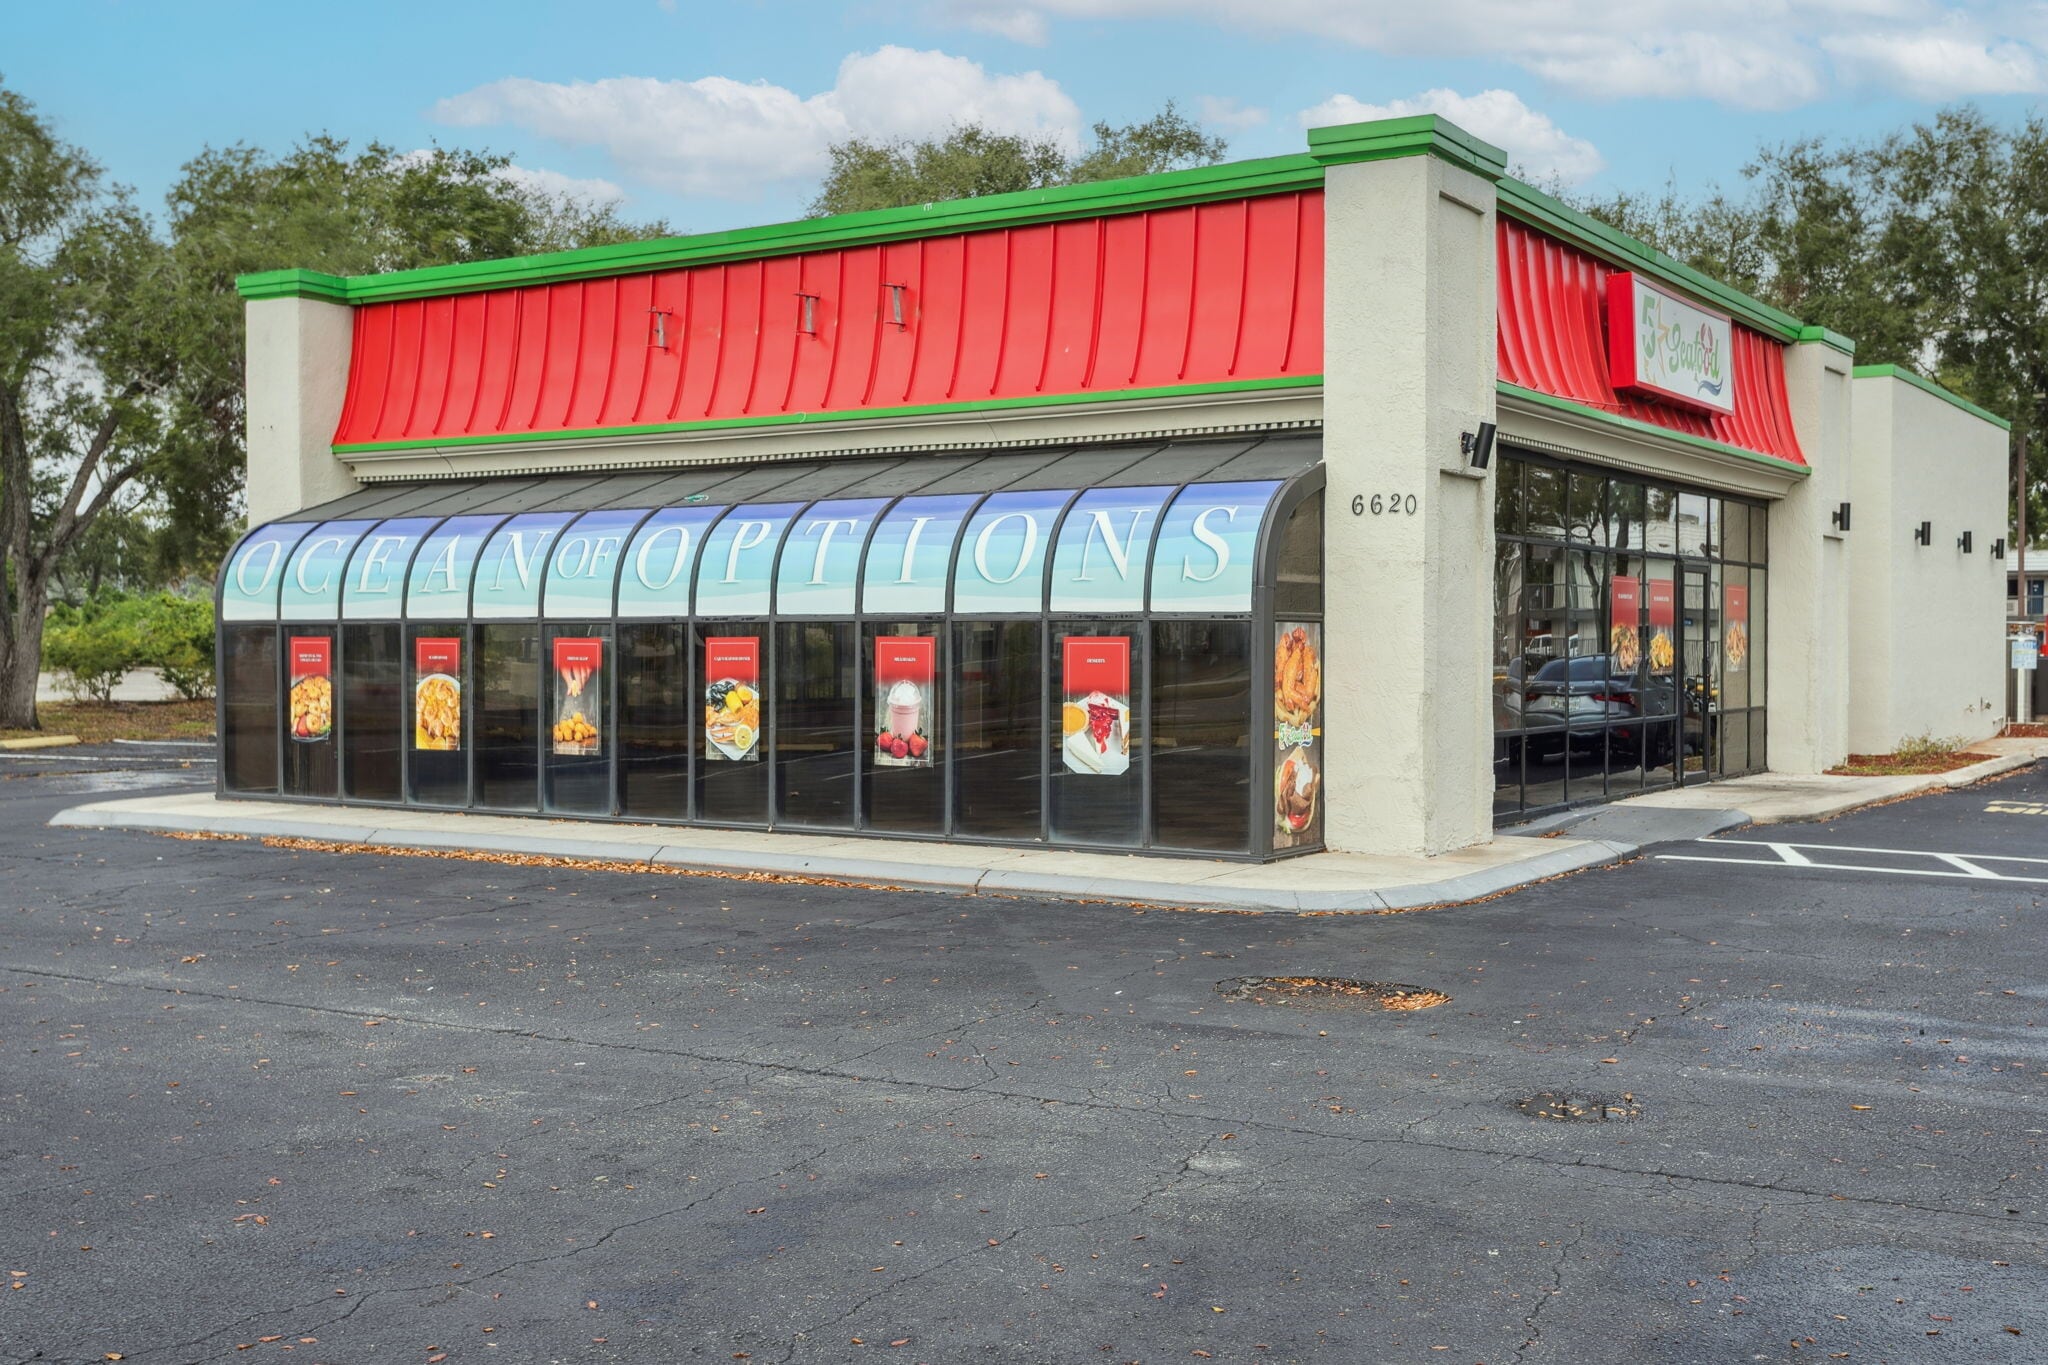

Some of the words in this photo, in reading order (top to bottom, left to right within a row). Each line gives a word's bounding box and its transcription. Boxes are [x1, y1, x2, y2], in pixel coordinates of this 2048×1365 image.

[1642, 294, 1656, 359] 5
[1666, 322, 1720, 381] Seafood
[1351, 493, 1417, 516] 6620
[236, 530, 554, 596] OCEAN
[556, 537, 620, 579] OF
[635, 505, 1239, 591] OPTIONS
